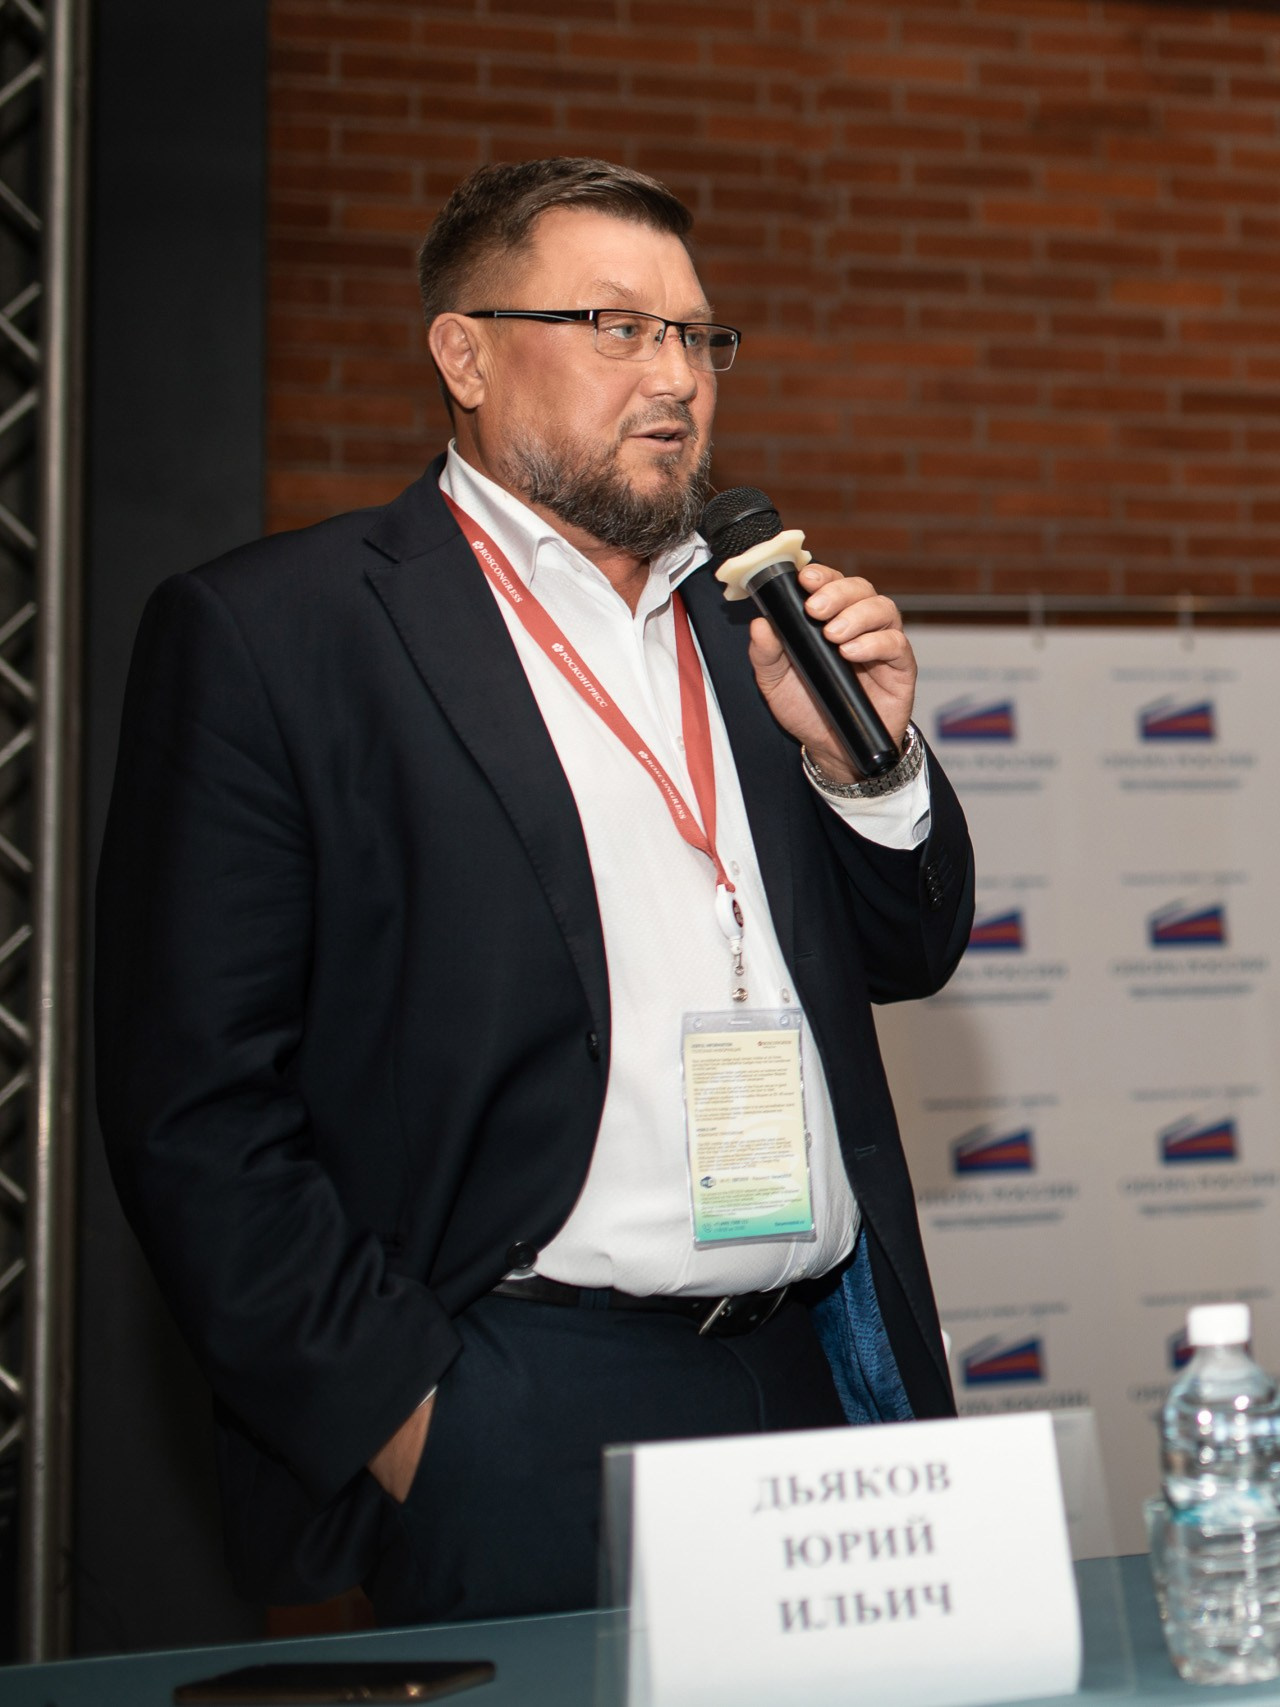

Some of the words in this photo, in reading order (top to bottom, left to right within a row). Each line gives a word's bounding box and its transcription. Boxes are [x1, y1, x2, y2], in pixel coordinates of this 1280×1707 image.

[479, 548, 523, 603] ROSCONGRESS
[559, 651, 608, 708] РОСКОНГРЕСС
[752, 1462, 951, 1514] ДЬЯКОВ
[783, 1514, 935, 1569] ЮРИЙ
[779, 1582, 953, 1635] ИЛЬИЧ
